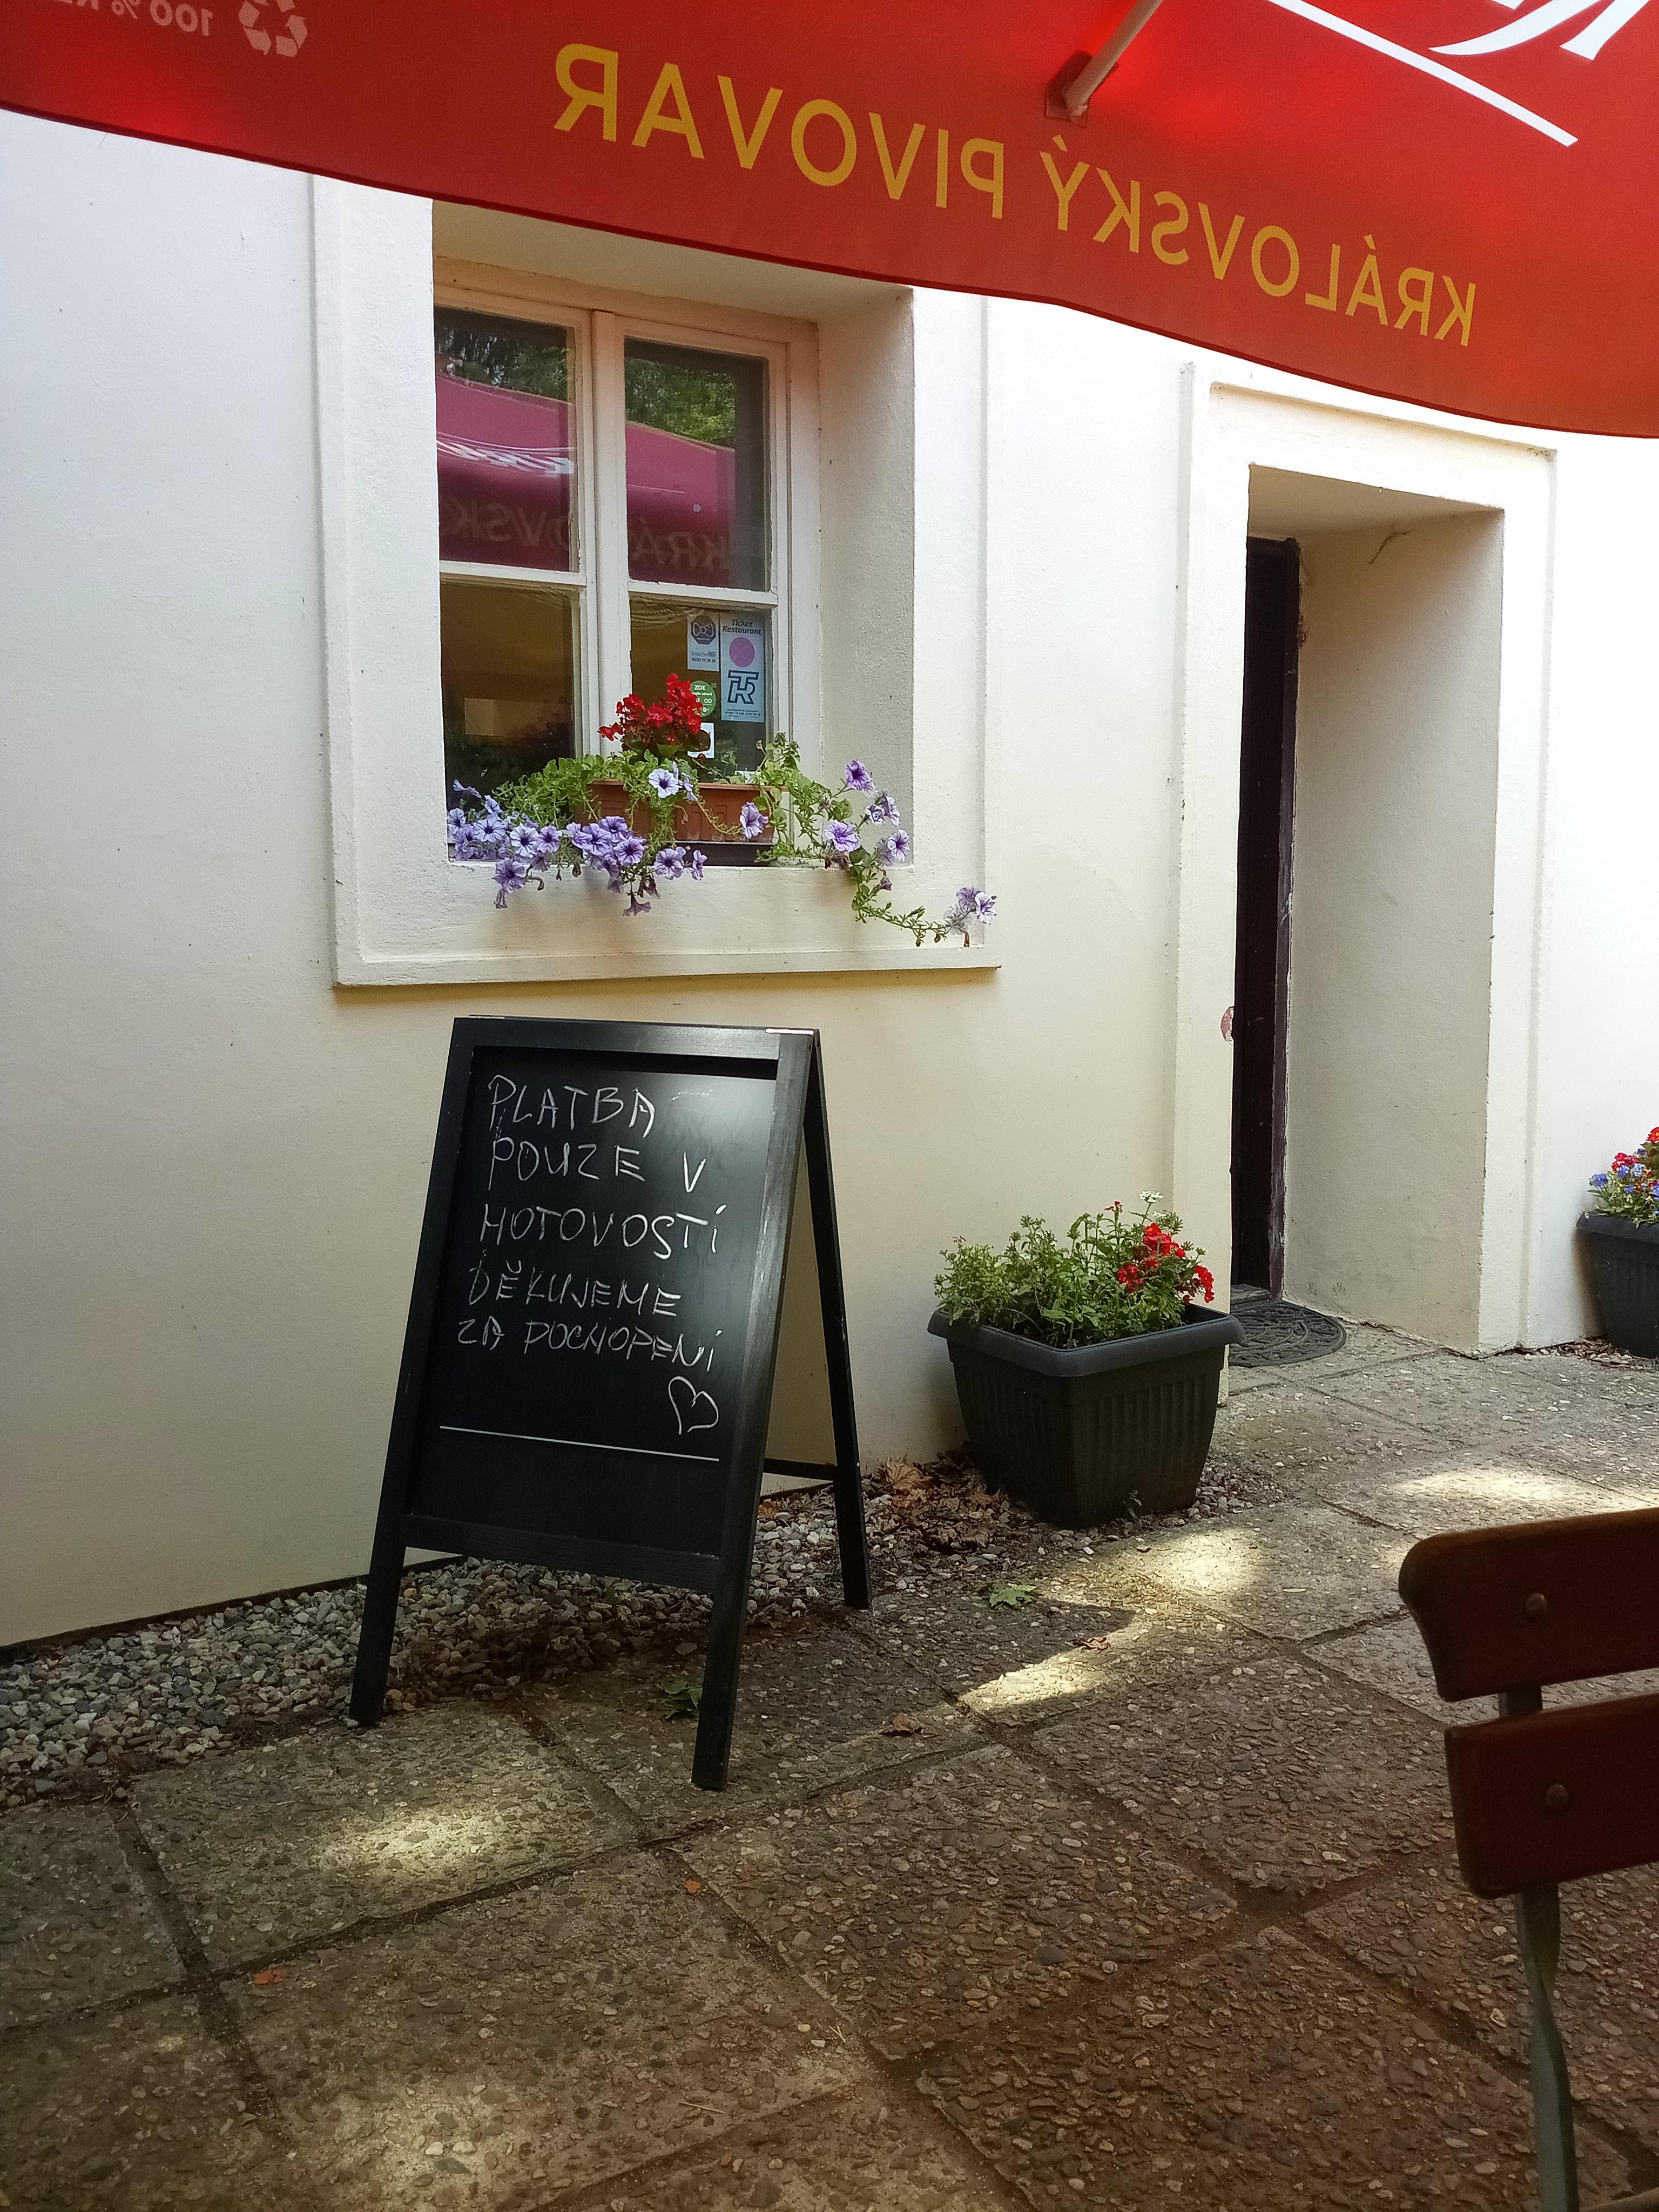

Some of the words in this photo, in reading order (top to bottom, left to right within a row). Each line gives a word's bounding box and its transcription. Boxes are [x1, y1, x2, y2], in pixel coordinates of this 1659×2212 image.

[723, 625, 762, 635] Restaurant
[488, 1075, 655, 1138] PLATBA
[488, 1137, 645, 1190] POUZE
[683, 1152, 706, 1192] V
[480, 1204, 727, 1259] HOTOVOSTÍ
[469, 1260, 682, 1317] DĚKUJEME
[458, 1316, 504, 1350] ZA
